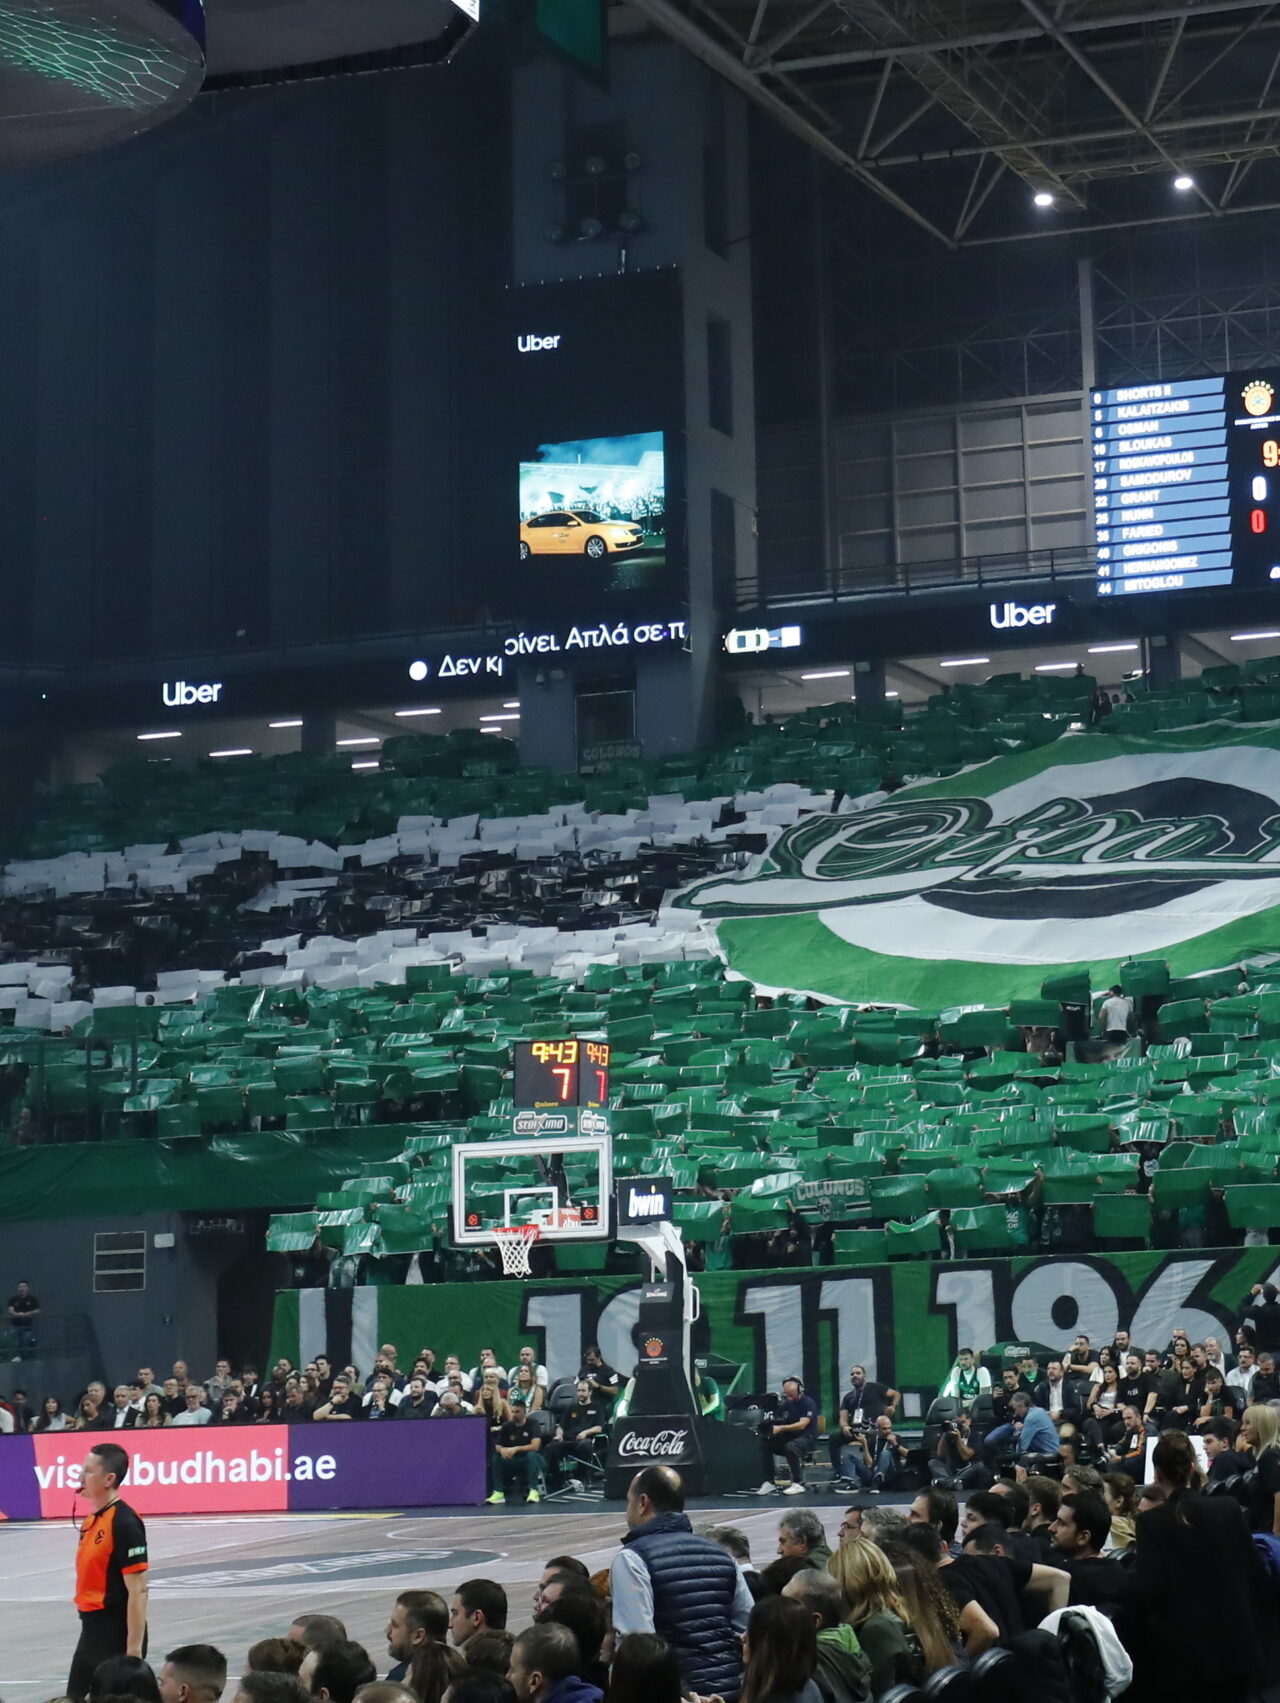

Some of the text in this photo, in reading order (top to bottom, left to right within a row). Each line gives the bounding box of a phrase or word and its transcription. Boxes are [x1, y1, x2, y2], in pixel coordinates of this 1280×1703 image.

[517, 334, 561, 353] Uber
[1117, 386, 1162, 401] SHORTS
[1118, 400, 1189, 418] KALAITZAKIS
[1118, 421, 1159, 435] OSMAN
[1119, 436, 1172, 452] SLOUKAS
[1094, 461, 1106, 472] 17
[1095, 469, 1192, 490] 20 SAMODUROV
[1252, 476, 1267, 501] 0
[1095, 490, 1160, 507] 22 GRANT
[1096, 508, 1153, 525] 25 NUNN
[1251, 509, 1265, 533] 0
[1122, 525, 1163, 539] FARIED
[1123, 540, 1178, 556] GRIGONIS
[1098, 565, 1110, 576] 41
[1099, 575, 1183, 594] 44 MITOGLOU
[990, 602, 1056, 629] Uber
[565, 622, 628, 650] Απλά
[633, 624, 663, 643] σε
[438, 655, 481, 677] Δεν
[162, 681, 222, 707] Uber
[532, 1041, 578, 1064] 9:43
[587, 1043, 609, 1067] 9:43
[552, 1068, 570, 1100] 7
[595, 1070, 606, 1102] 7
[629, 1185, 665, 1218] bwin
[34, 1448, 337, 1490] visbudhabi.ae
